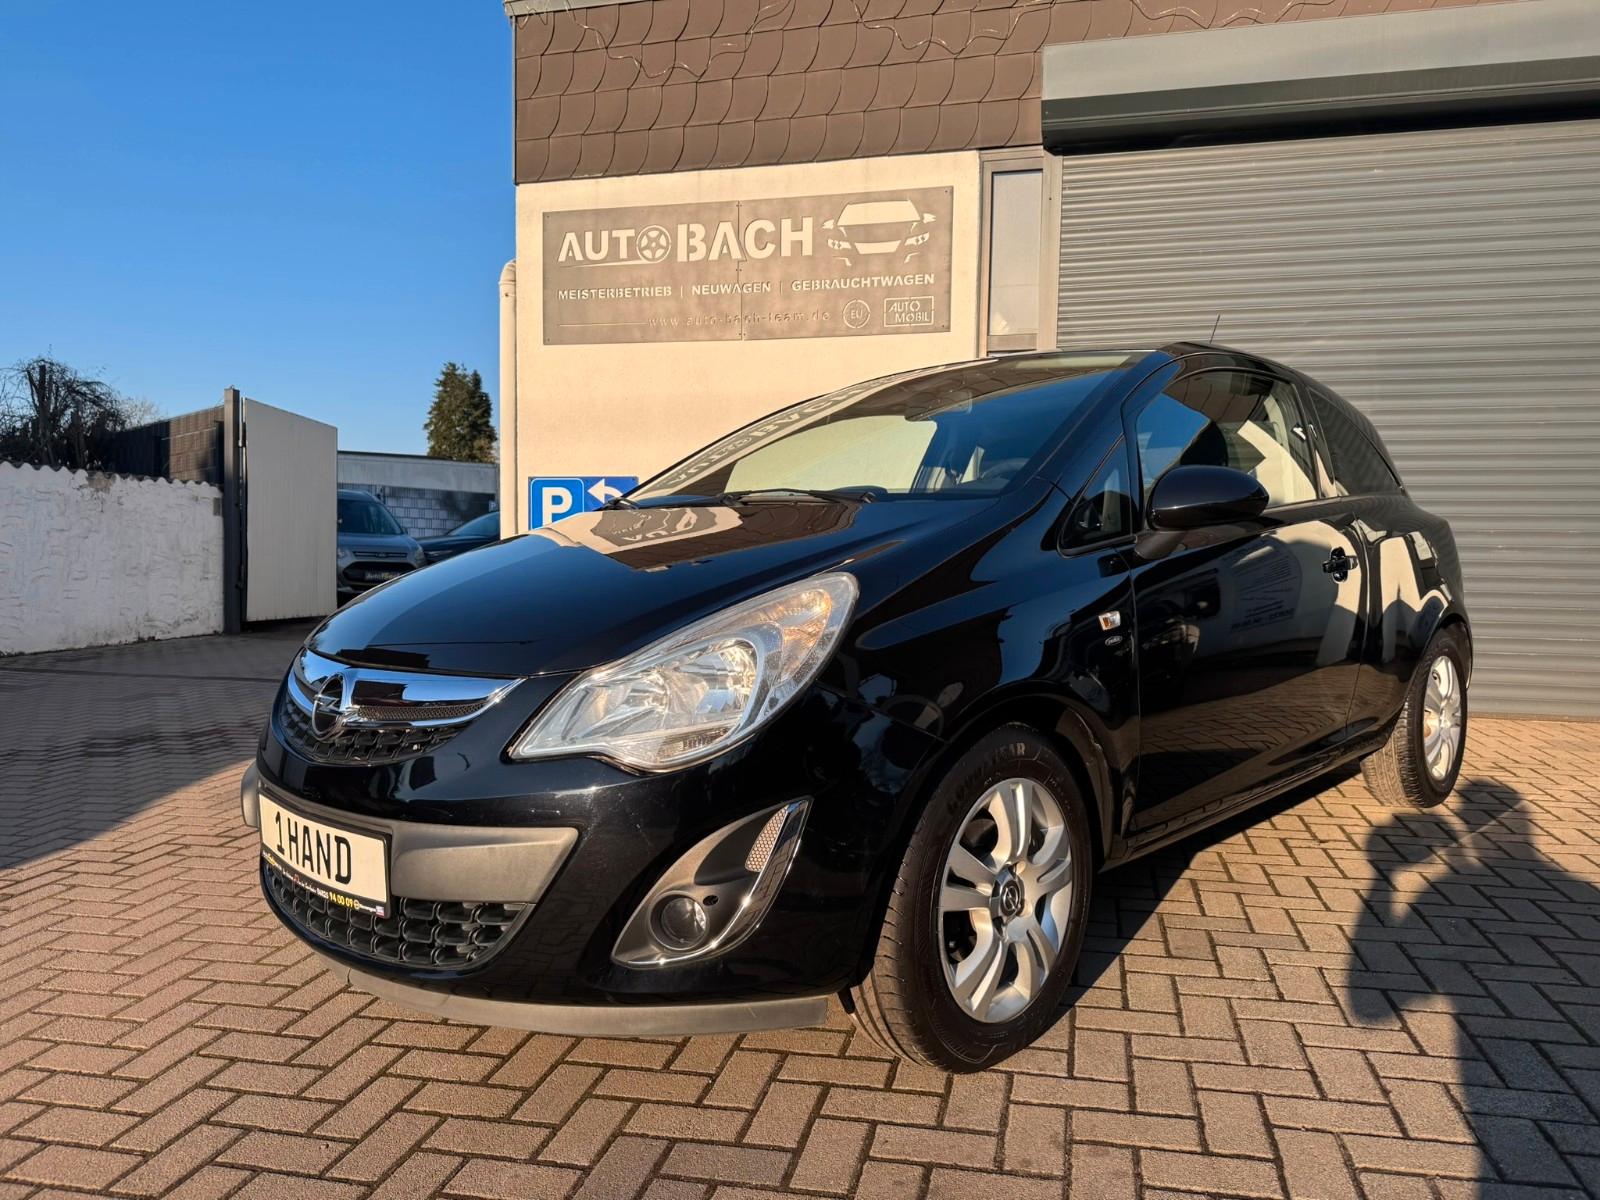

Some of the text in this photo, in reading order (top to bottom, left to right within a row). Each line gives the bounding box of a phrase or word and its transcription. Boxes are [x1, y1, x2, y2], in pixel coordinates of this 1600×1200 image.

[558, 273, 935, 300] MEISTERBETRIEB NEUWAGEN GEBRAUCHTWAGEN
[850, 308, 863, 319] EU
[888, 300, 921, 313] AUTO
[894, 311, 930, 323] MOBIL
[541, 486, 573, 527] P
[275, 811, 351, 884] 1 HAND
